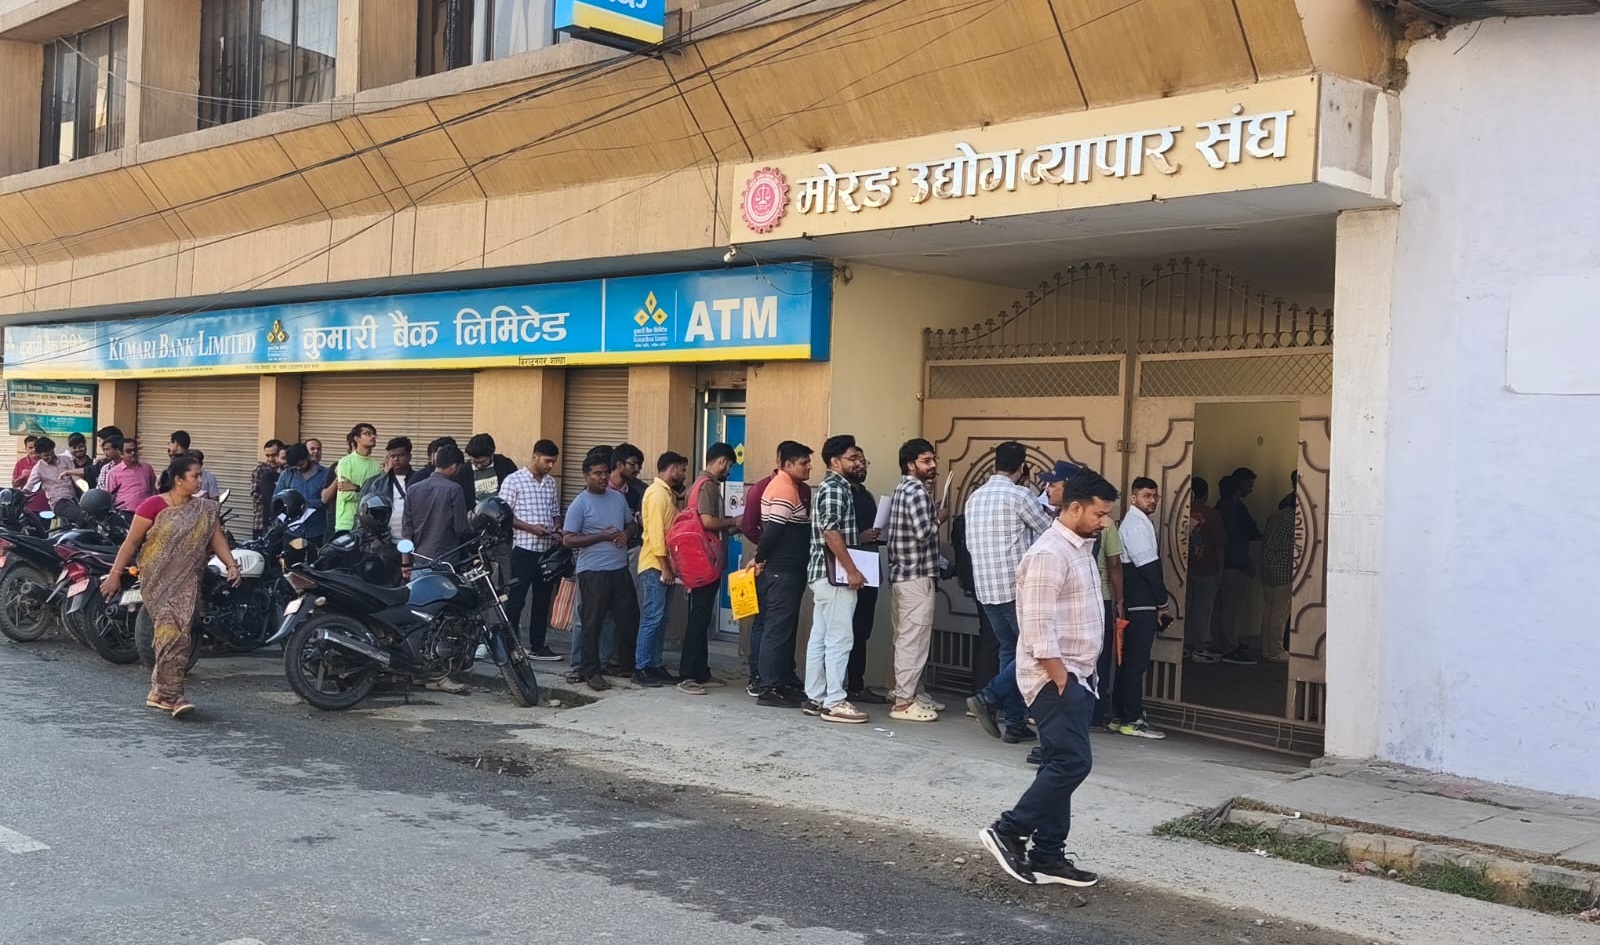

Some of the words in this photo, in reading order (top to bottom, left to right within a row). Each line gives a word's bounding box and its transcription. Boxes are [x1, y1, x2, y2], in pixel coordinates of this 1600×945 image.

[795, 163, 899, 215] मोरङ
[906, 141, 1023, 204] उद्योग
[1020, 125, 1185, 185] व्यापार
[1195, 103, 1296, 169] संघ
[302, 314, 380, 360] कुमारी
[388, 309, 440, 348] बैंक
[452, 304, 570, 346] लिमिटेड
[684, 295, 778, 343] ATM
[109, 337, 158, 361] KUMARI
[159, 333, 195, 359] BANK
[198, 330, 257, 357] LIMITED
